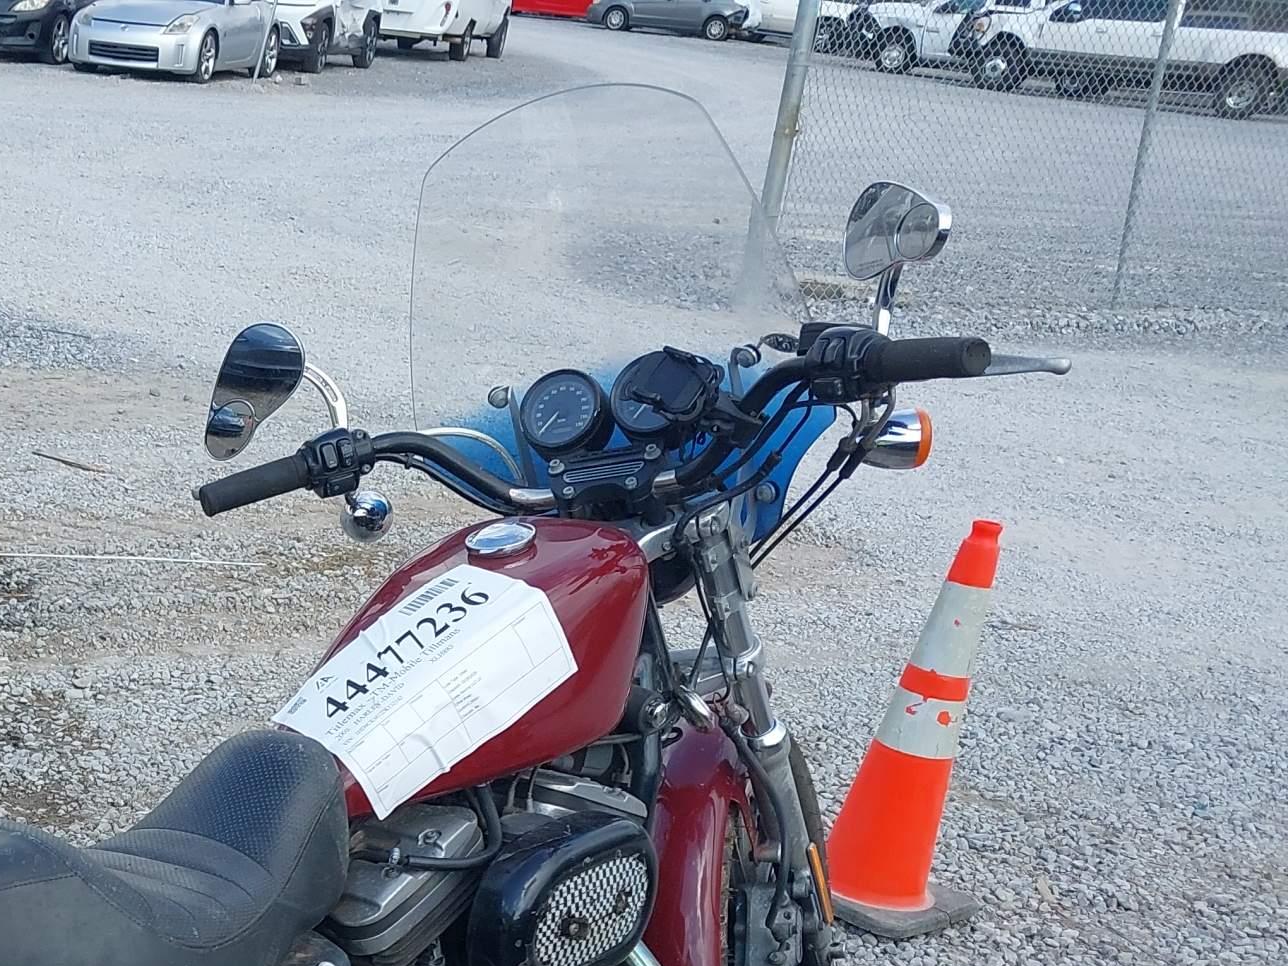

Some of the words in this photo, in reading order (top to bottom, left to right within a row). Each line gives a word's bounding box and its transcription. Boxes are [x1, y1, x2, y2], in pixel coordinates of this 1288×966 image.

[325, 703, 366, 735] Titlemax
[420, 628, 461, 656] Tillmans
[327, 585, 489, 718] 44477236
